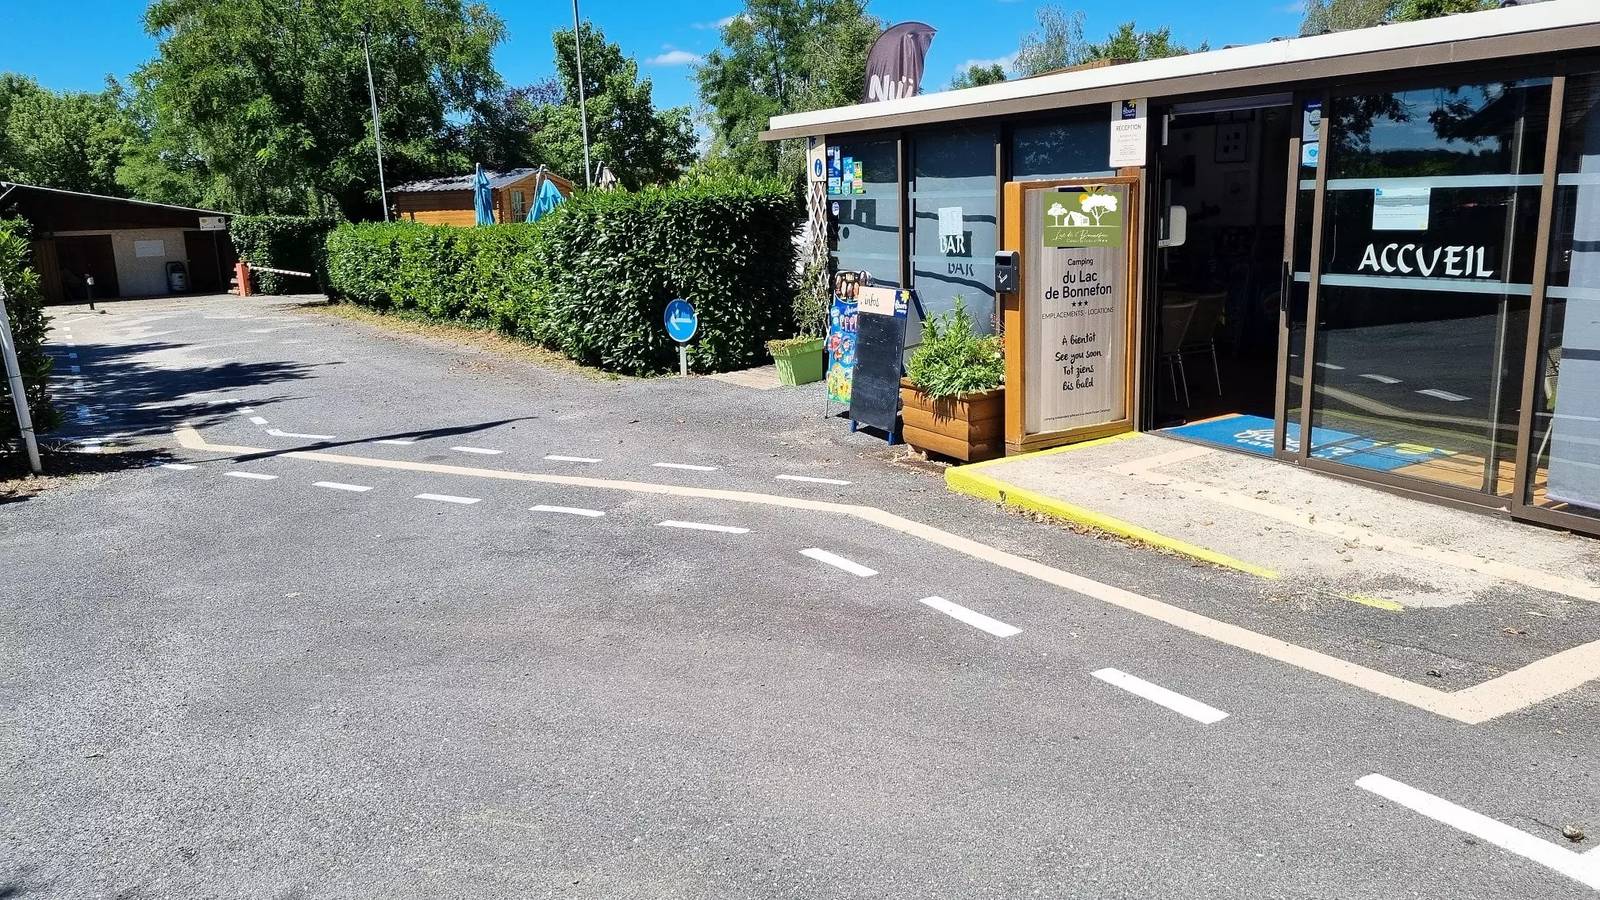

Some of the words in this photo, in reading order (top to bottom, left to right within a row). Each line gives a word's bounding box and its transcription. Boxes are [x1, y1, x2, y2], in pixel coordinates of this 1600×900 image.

[939, 235, 966, 254] BAR
[1067, 257, 1094, 267] Camping
[1062, 270, 1076, 284] du
[1079, 270, 1098, 283] Lac
[1045, 286, 1060, 300] de
[1062, 283, 1112, 298] Bonnefon
[1041, 310, 1085, 319] EMPLACEMENTS
[1088, 306, 1115, 316] LOCATIONS
[1070, 332, 1096, 345] bientôt
[1055, 351, 1068, 362] See
[1070, 352, 1084, 364] you
[1085, 350, 1102, 359] soon
[1063, 365, 1074, 375] Tot
[1076, 365, 1094, 378] ziens
[1075, 377, 1094, 389] bald
